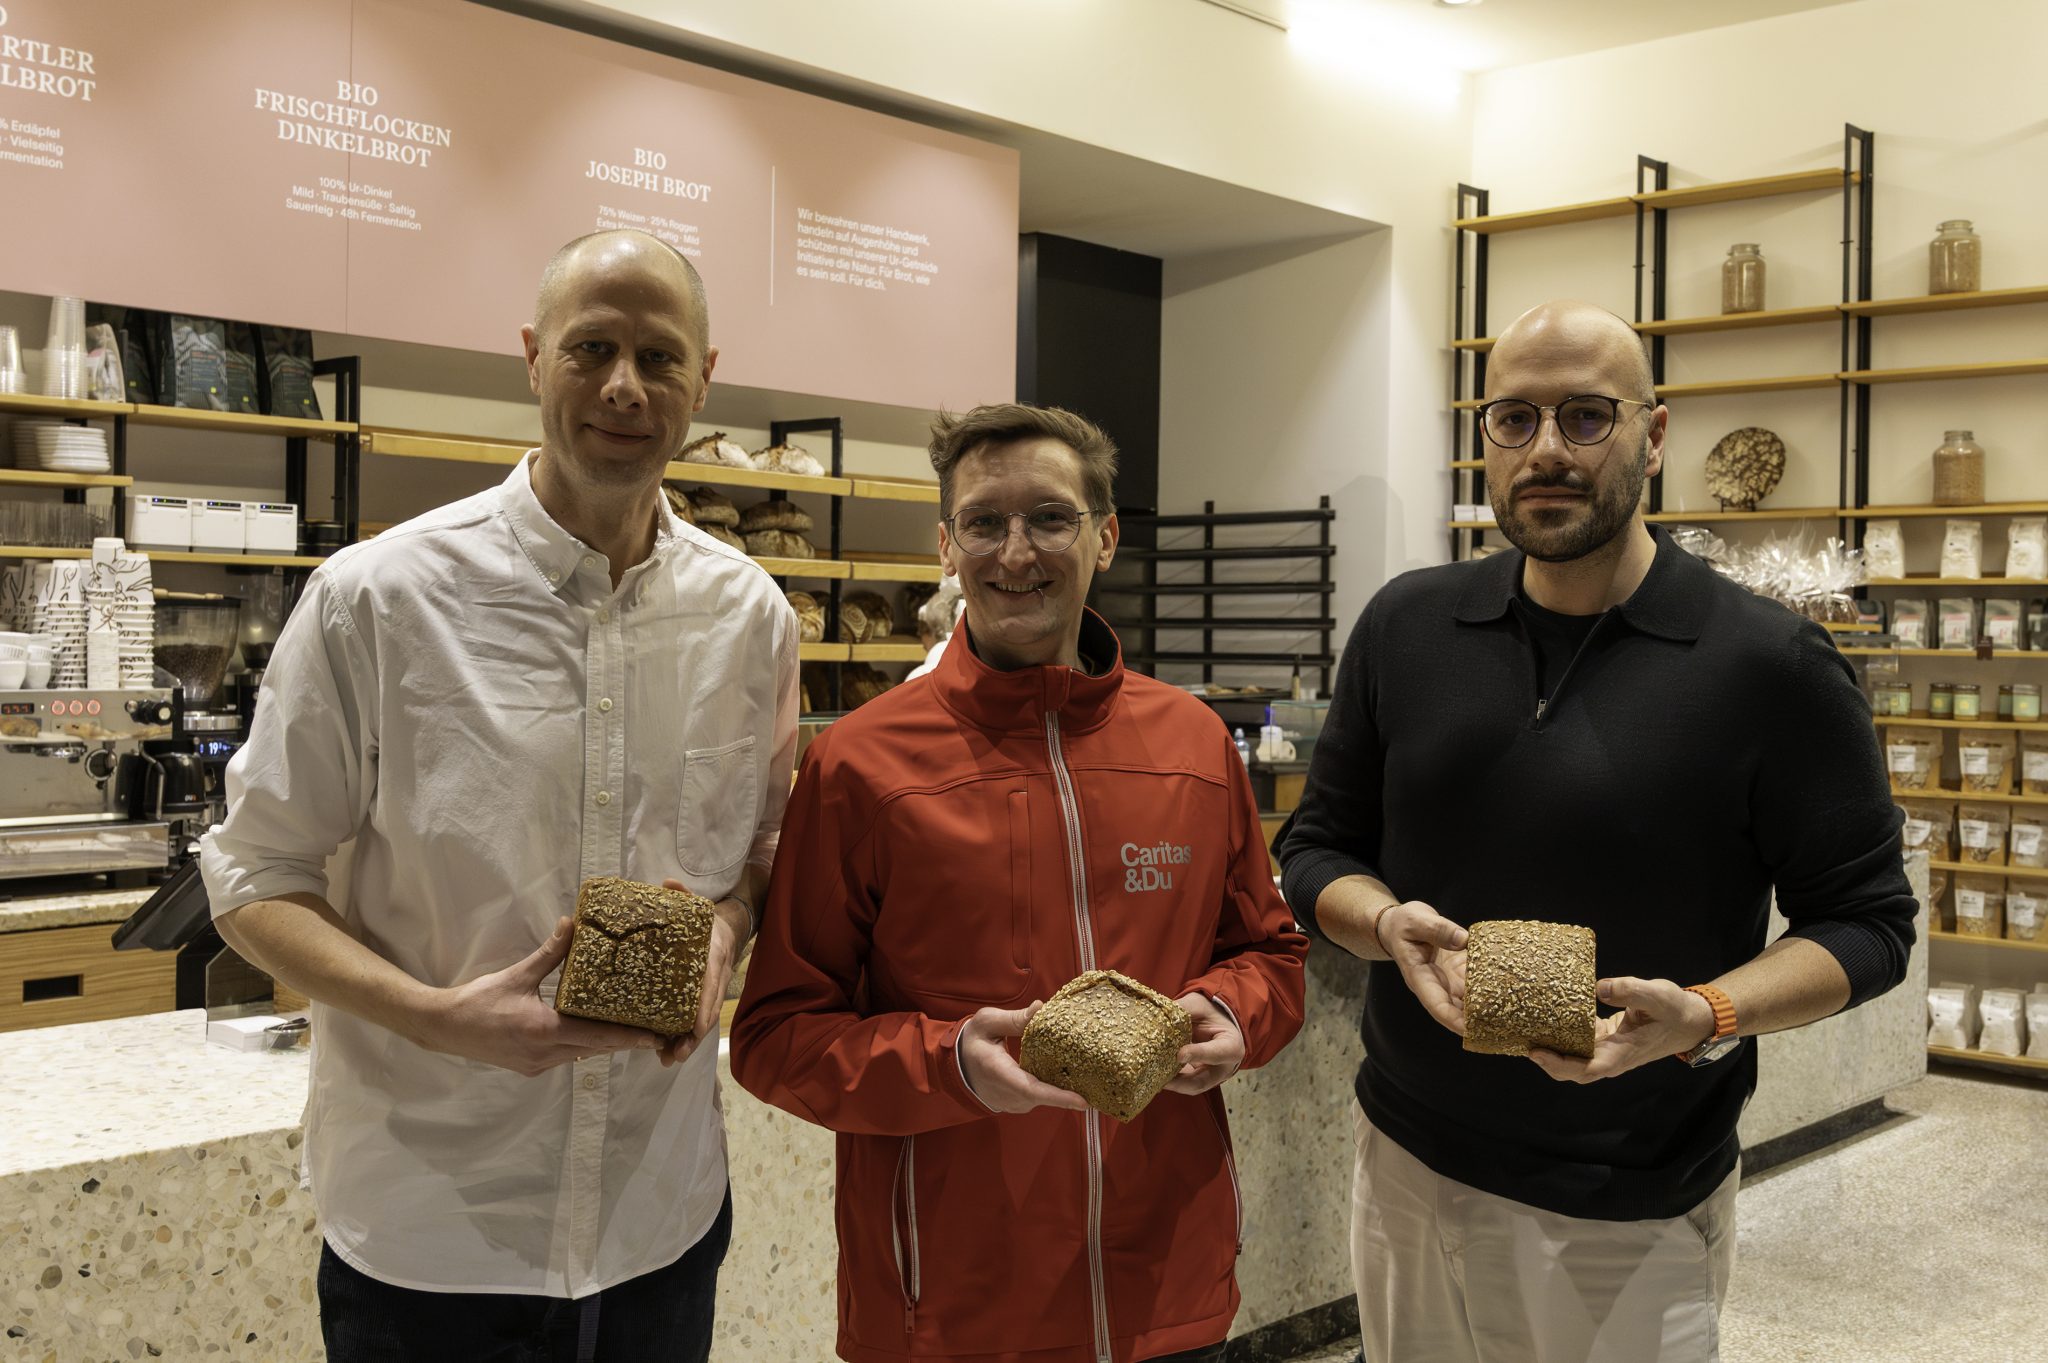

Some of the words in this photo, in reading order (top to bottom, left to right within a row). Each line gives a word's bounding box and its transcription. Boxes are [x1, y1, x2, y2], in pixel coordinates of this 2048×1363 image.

[0, 34, 96, 75] RTLER
[0, 63, 97, 102] LBROT
[336, 80, 378, 106] BIO
[11, 119, 61, 139] Erdäpfel
[254, 88, 452, 148] FRISCHFLOCKEN
[10, 135, 64, 157] Vielseitig
[277, 119, 432, 168] DINKELBROT
[634, 148, 667, 170] BIO
[0, 151, 63, 169] rmentation
[319, 176, 346, 191] 100%
[348, 181, 393, 199] Ur-Dinkel
[585, 160, 658, 192] JOSEPH
[663, 176, 711, 202] BROT
[286, 198, 334, 218] Sauerteig
[340, 208, 360, 220] 48h
[361, 209, 422, 232] Fermentation
[292, 185, 315, 199] Mild
[320, 190, 382, 211] Traubensüße
[388, 203, 416, 219] Saftig
[599, 205, 617, 218] 75%
[618, 209, 646, 224] Weizen
[651, 216, 668, 229] 25%
[669, 219, 698, 234] Roggen
[797, 207, 814, 221] Wir
[815, 212, 859, 231] bewahren
[860, 223, 885, 236] unser
[886, 226, 930, 247] Handwerk,
[683, 234, 700, 246] Mild
[797, 222, 835, 240] handeln
[835, 231, 850, 243] auf
[851, 233, 901, 254] Augenhöhe
[902, 245, 919, 257] und
[797, 237, 839, 254] schützen
[839, 245, 854, 258] mit
[855, 249, 888, 264] unserer
[889, 254, 939, 275] Ur-Getreide
[797, 250, 835, 268] Initiative
[836, 257, 851, 271] die
[852, 260, 878, 277] Natur.
[879, 265, 894, 279] Für
[894, 268, 914, 285] Brot,
[915, 275, 931, 287] wie
[796, 266, 808, 278] es
[809, 268, 829, 281] sein
[830, 271, 848, 285] soll.
[849, 274, 864, 287] Für
[864, 276, 886, 291] dich.
[1120, 841, 1191, 867] Caritas
[1124, 866, 1173, 893] &Du
